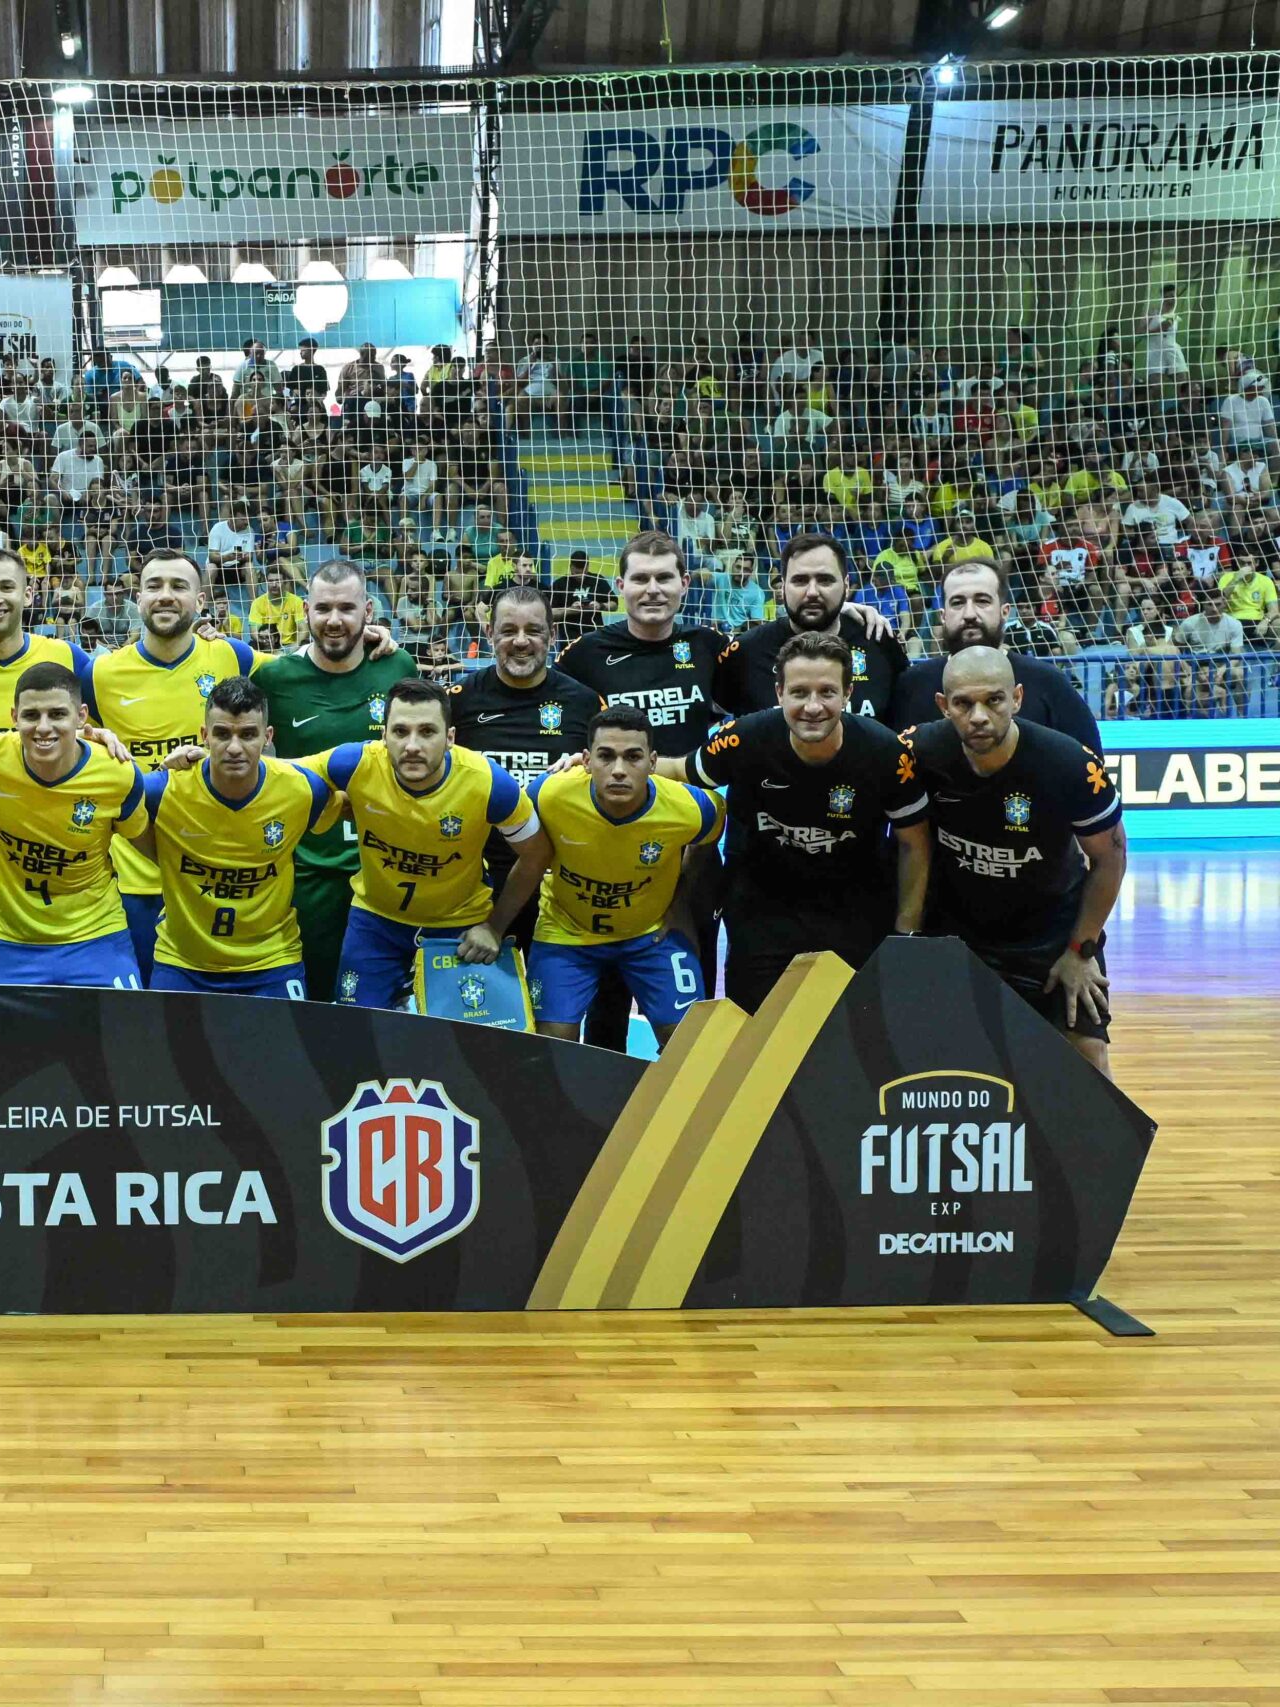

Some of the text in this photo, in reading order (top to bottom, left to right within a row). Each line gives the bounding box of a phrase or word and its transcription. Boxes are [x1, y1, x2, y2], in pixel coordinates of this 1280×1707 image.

[990, 122, 1265, 174] PANORAMA
[578, 121, 821, 216] RPC
[110, 150, 440, 214] polpanorte
[1054, 182, 1193, 201] HOME CENTER
[266, 291, 297, 303] SAÍDA
[647, 704, 690, 727] BET
[706, 732, 741, 756] vivo
[1004, 824, 1031, 833] FUTSAL
[937, 825, 1044, 864] ESTRELA
[22, 855, 69, 876] BET
[180, 854, 278, 884] ESTRELA
[397, 861, 444, 877] BET
[973, 856, 1022, 878] BET
[24, 877, 53, 906] 4
[214, 882, 262, 900] BET
[396, 881, 417, 912] 7
[591, 893, 632, 909] BET
[210, 907, 236, 937] 8
[670, 951, 697, 993] 6
[463, 1009, 490, 1019] BRASIL
[901, 1089, 991, 1109] MUNDO DO
[75, 1104, 111, 1129] DE
[119, 1103, 222, 1128] FUTSAL
[859, 1121, 1034, 1195] FUTSAL
[358, 1114, 443, 1229] CR
[115, 1169, 278, 1226] RICA
[930, 1201, 962, 1216] EXP
[878, 1230, 1015, 1255] DECATHLON
